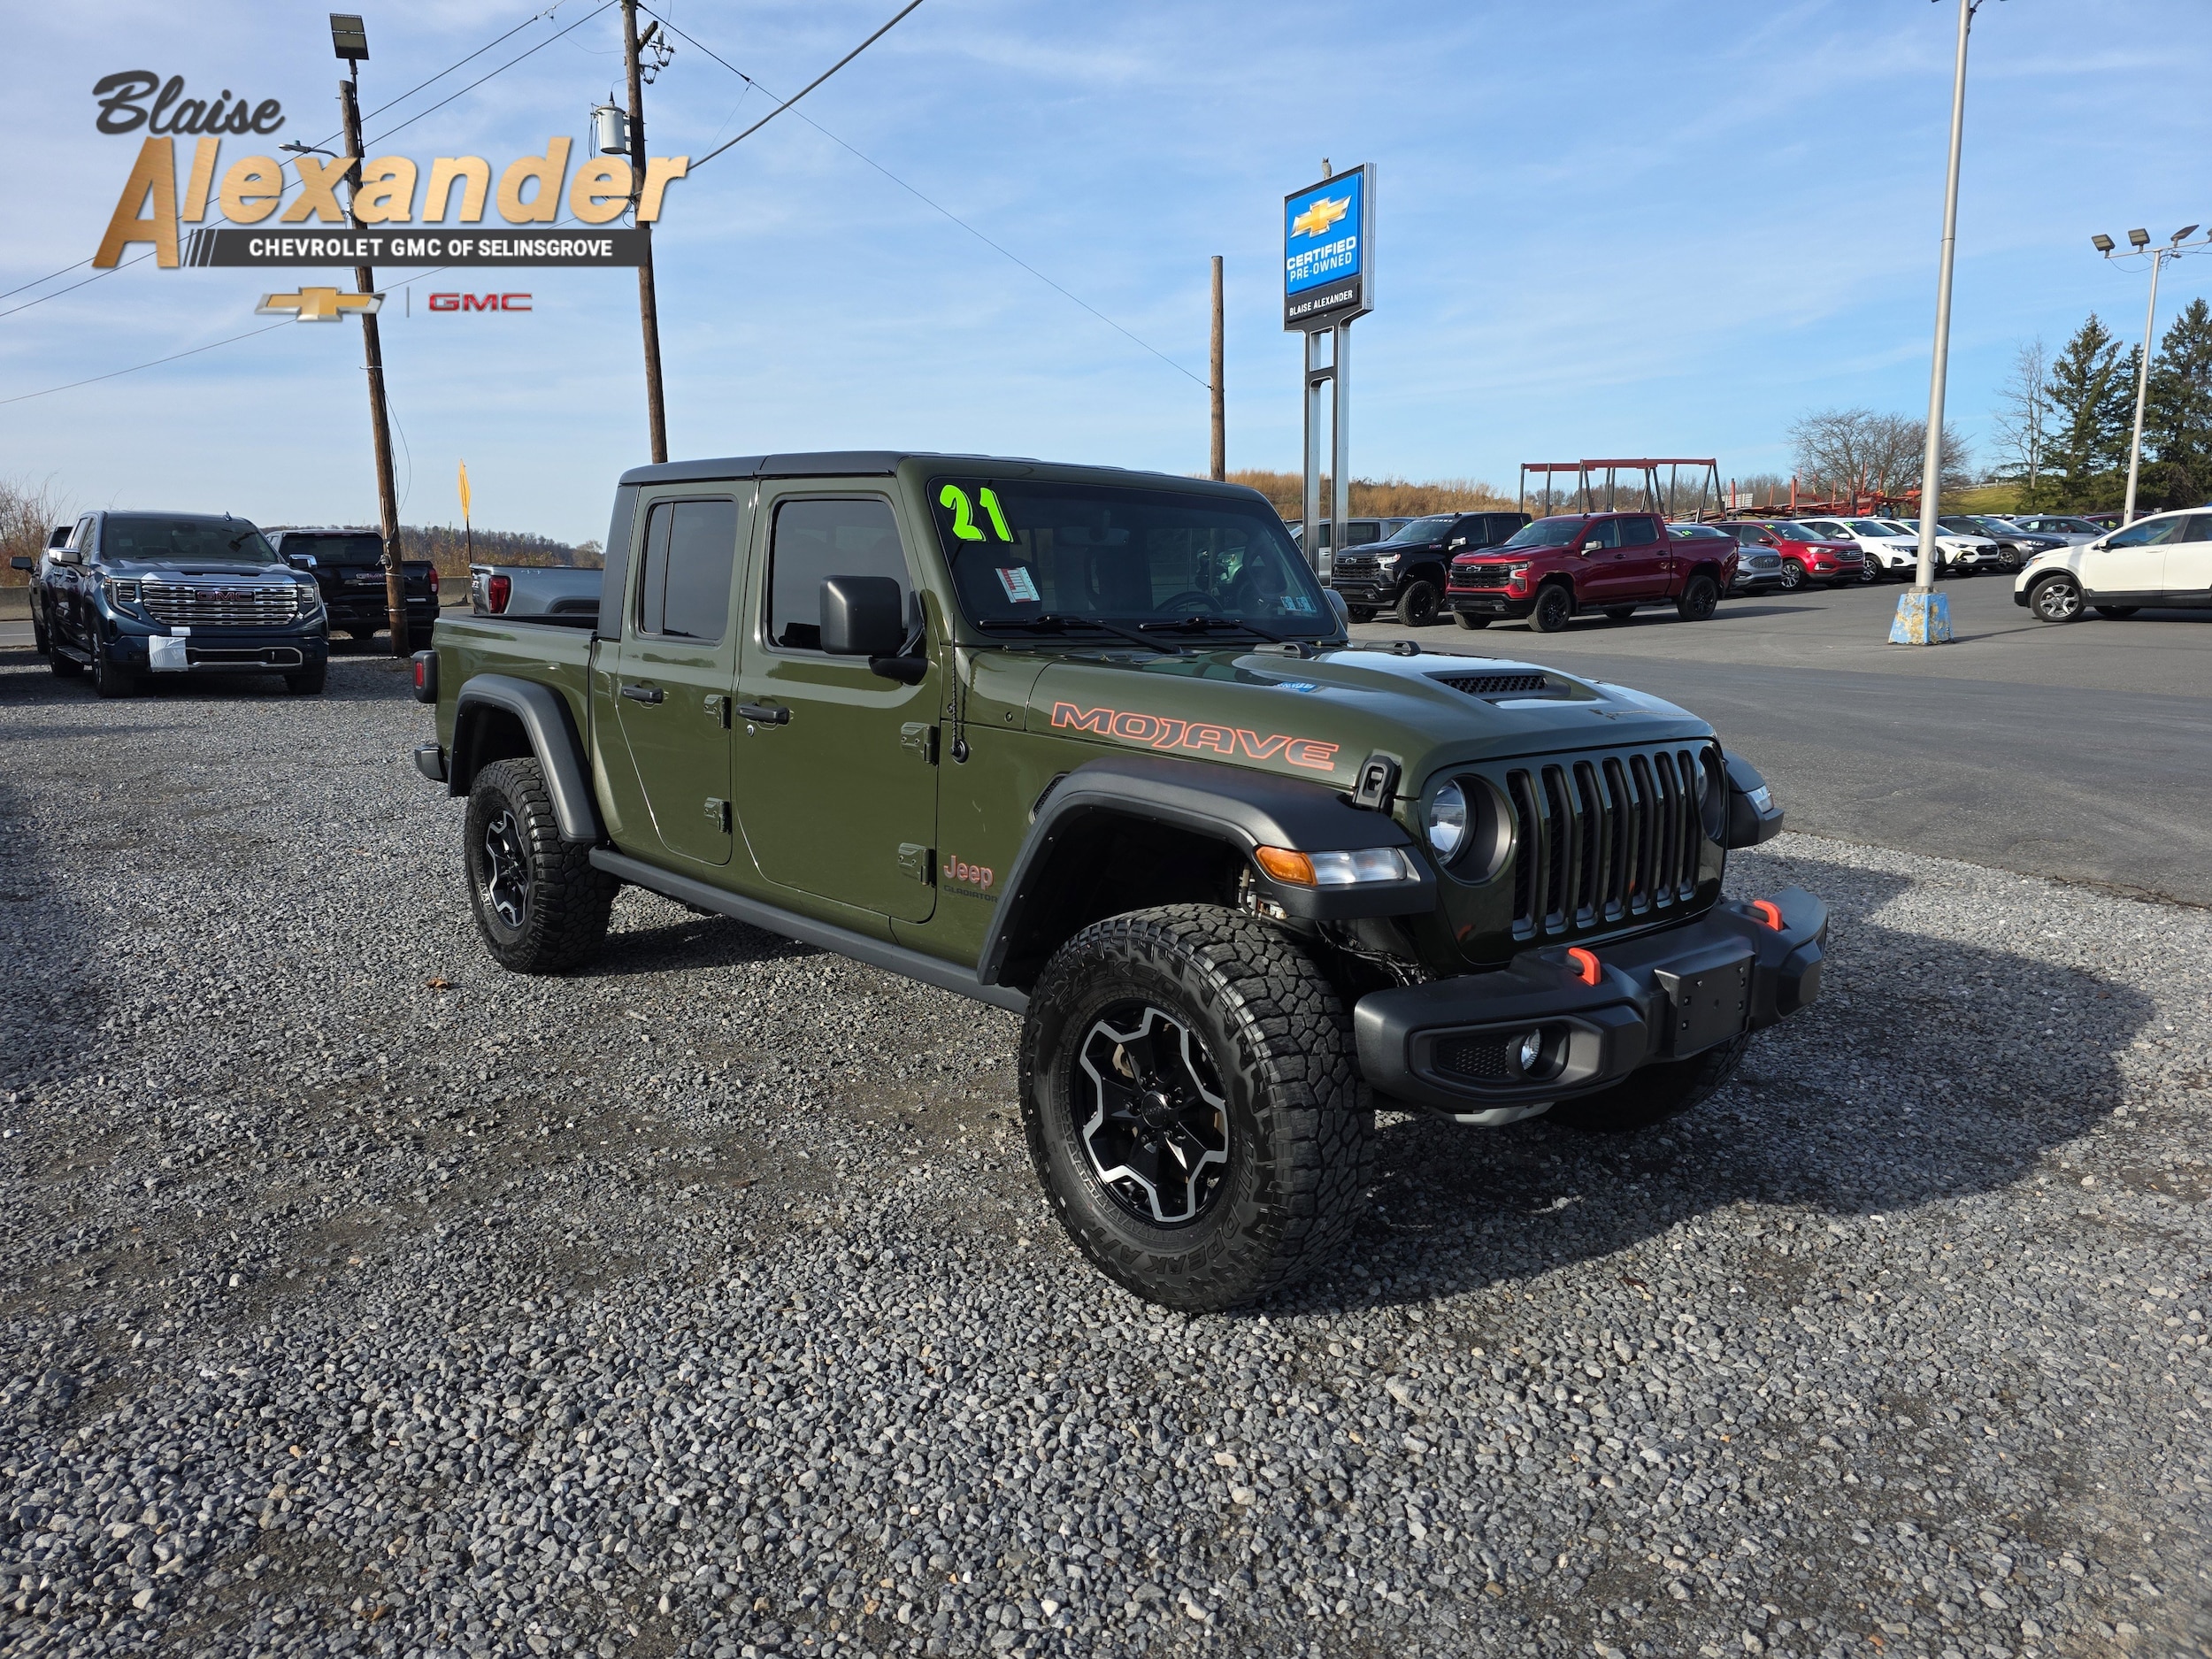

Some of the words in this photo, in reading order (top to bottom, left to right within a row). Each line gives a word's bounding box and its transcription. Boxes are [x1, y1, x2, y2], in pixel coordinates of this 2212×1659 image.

[1286, 235, 1356, 271] CERTIFIED
[1290, 251, 1352, 282] PRE-OWNED
[1289, 302, 1312, 317] BLAISE
[1313, 289, 1353, 310] ALEXANDER
[939, 484, 1015, 543] 21
[196, 590, 253, 602] GMC
[1050, 701, 1340, 772] MOJAVE
[943, 855, 994, 892] Jeep
[943, 885, 998, 903] GLADIATOR
